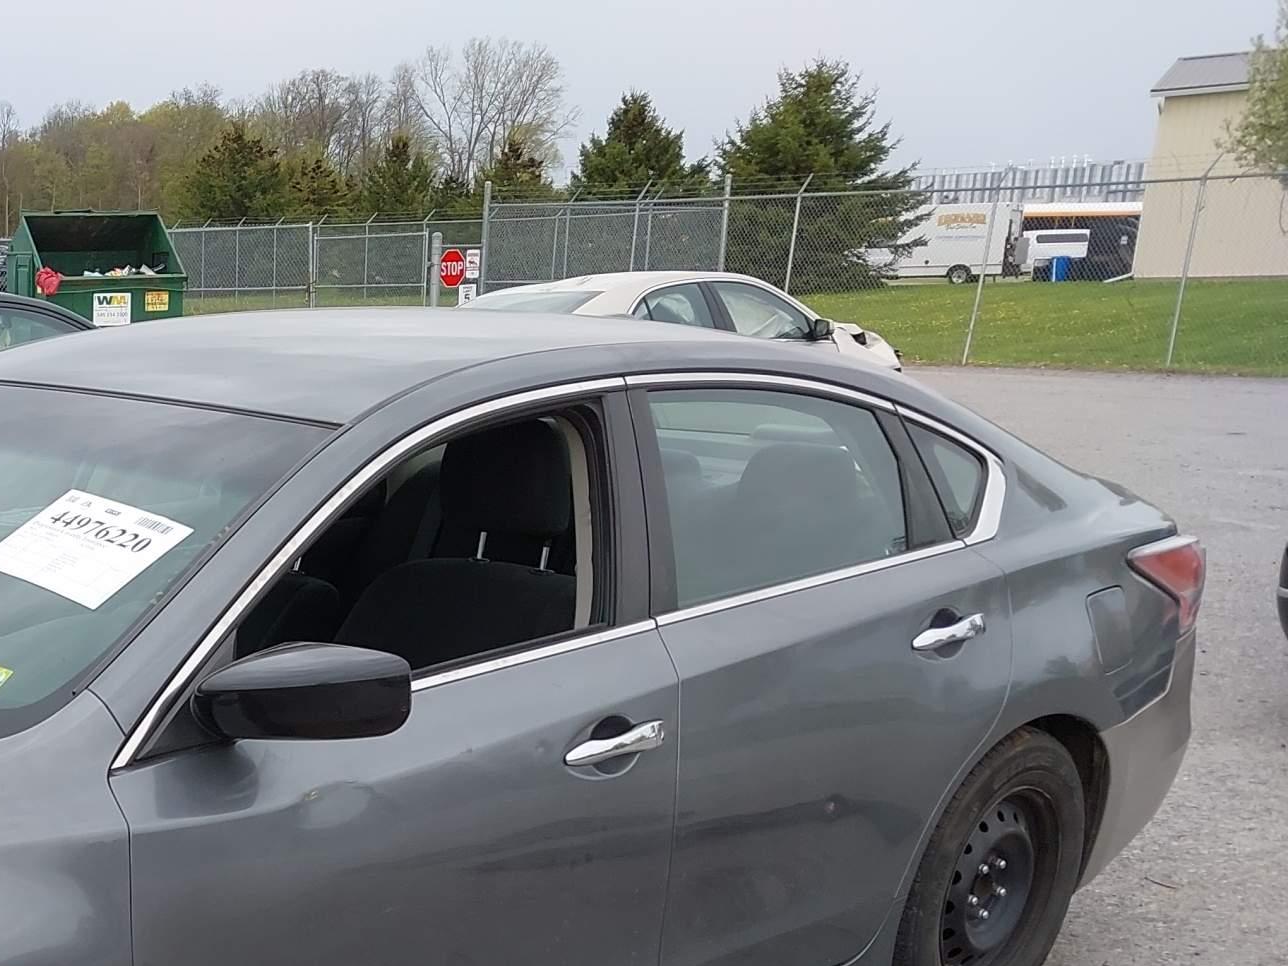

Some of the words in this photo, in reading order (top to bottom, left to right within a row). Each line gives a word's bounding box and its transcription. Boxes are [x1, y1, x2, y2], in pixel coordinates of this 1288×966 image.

[441, 262, 463, 276] STOP
[97, 295, 127, 305] WM
[464, 294, 470, 303] 5
[50, 510, 152, 553] 44976220
